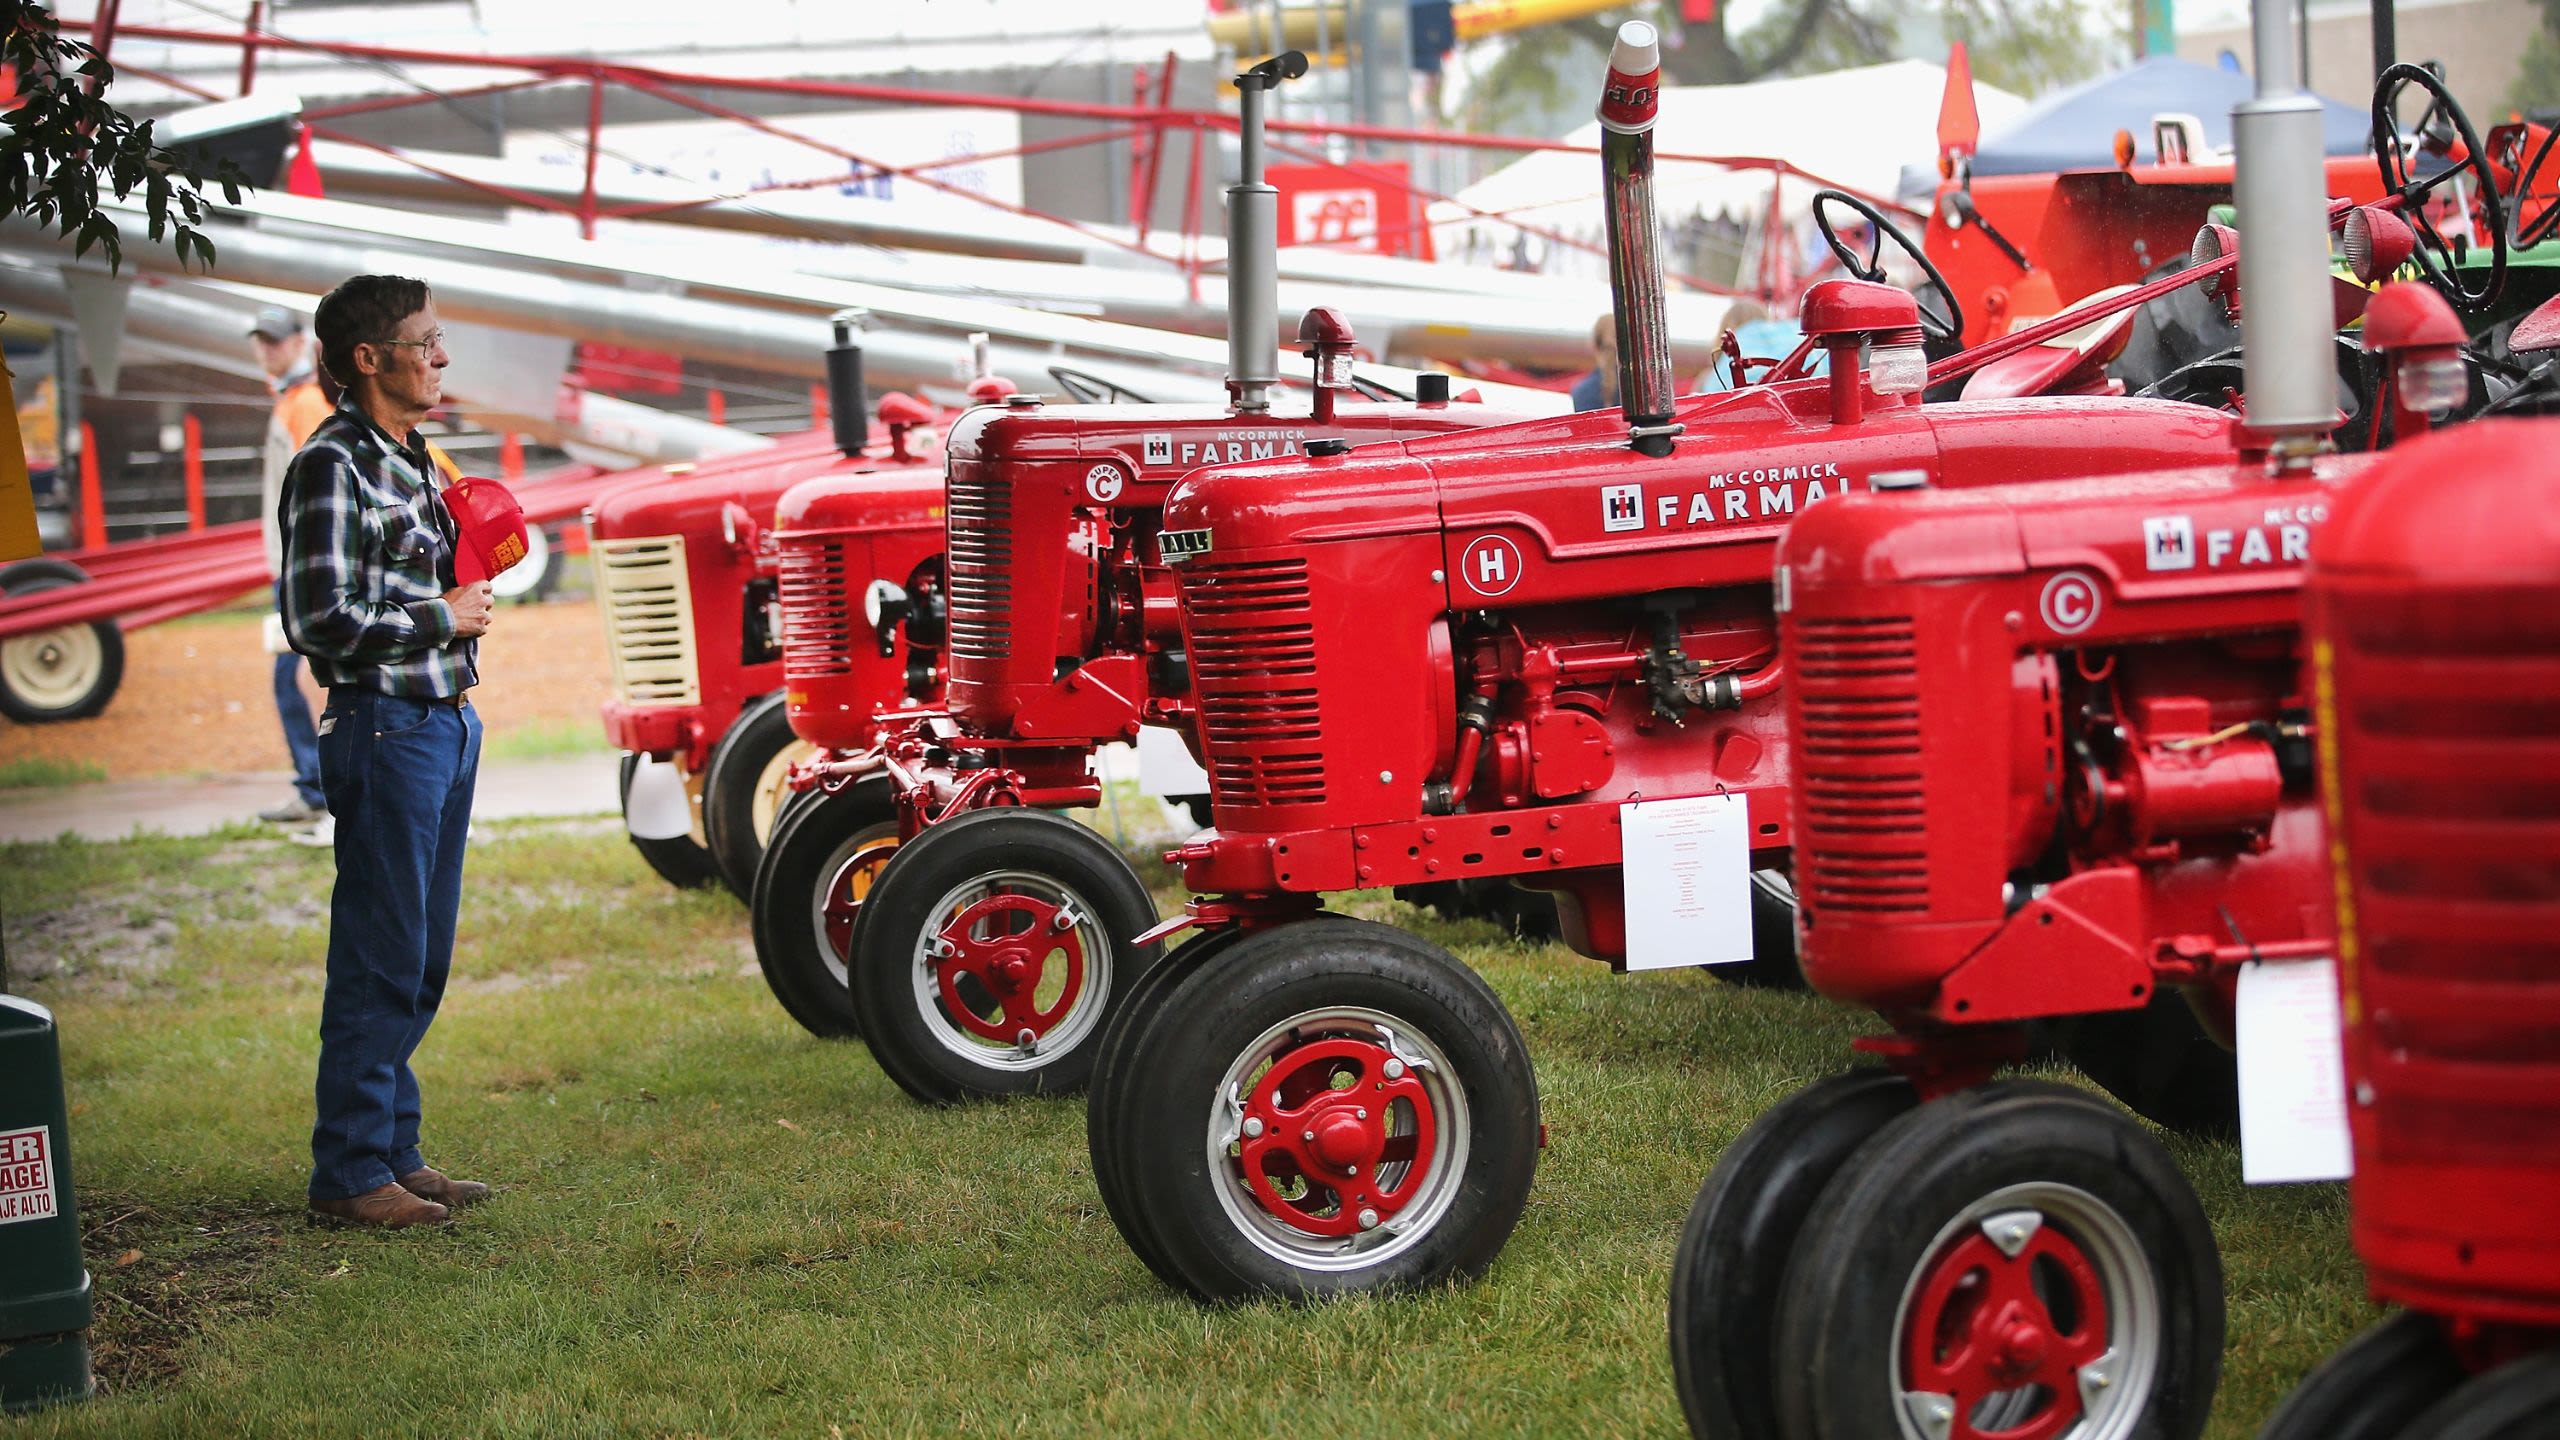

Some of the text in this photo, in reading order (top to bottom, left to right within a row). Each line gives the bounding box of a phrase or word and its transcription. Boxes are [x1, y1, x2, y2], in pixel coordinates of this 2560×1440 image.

[1090, 466, 1120, 481] SUPER
[1095, 475, 1112, 499] C
[1478, 547, 1506, 583] H
[2054, 583, 2086, 624] C
[21, 1192, 51, 1217] ALTO
